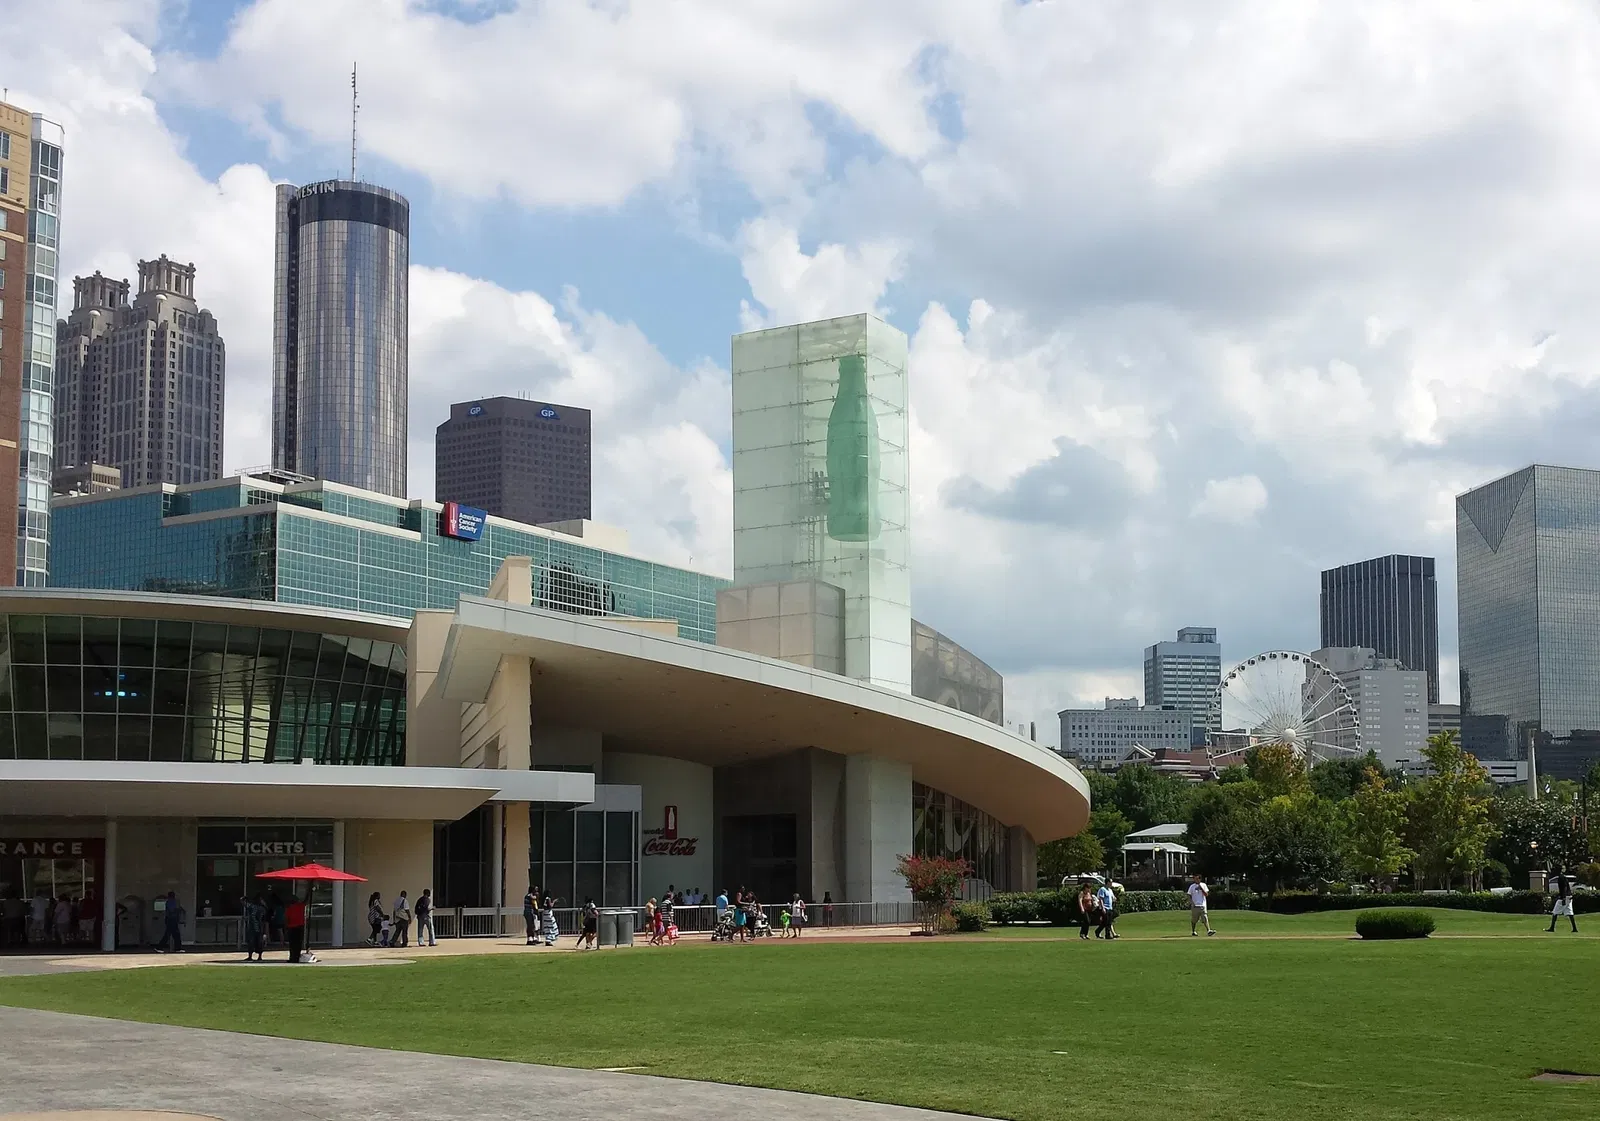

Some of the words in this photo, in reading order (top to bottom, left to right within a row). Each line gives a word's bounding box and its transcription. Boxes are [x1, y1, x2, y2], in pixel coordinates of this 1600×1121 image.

[470, 406, 481, 415] GP
[541, 409, 554, 417] GP
[459, 512, 482, 523] American
[459, 518, 476, 527] Cancer
[459, 524, 477, 534] Society
[234, 842, 304, 854] TICKETS
